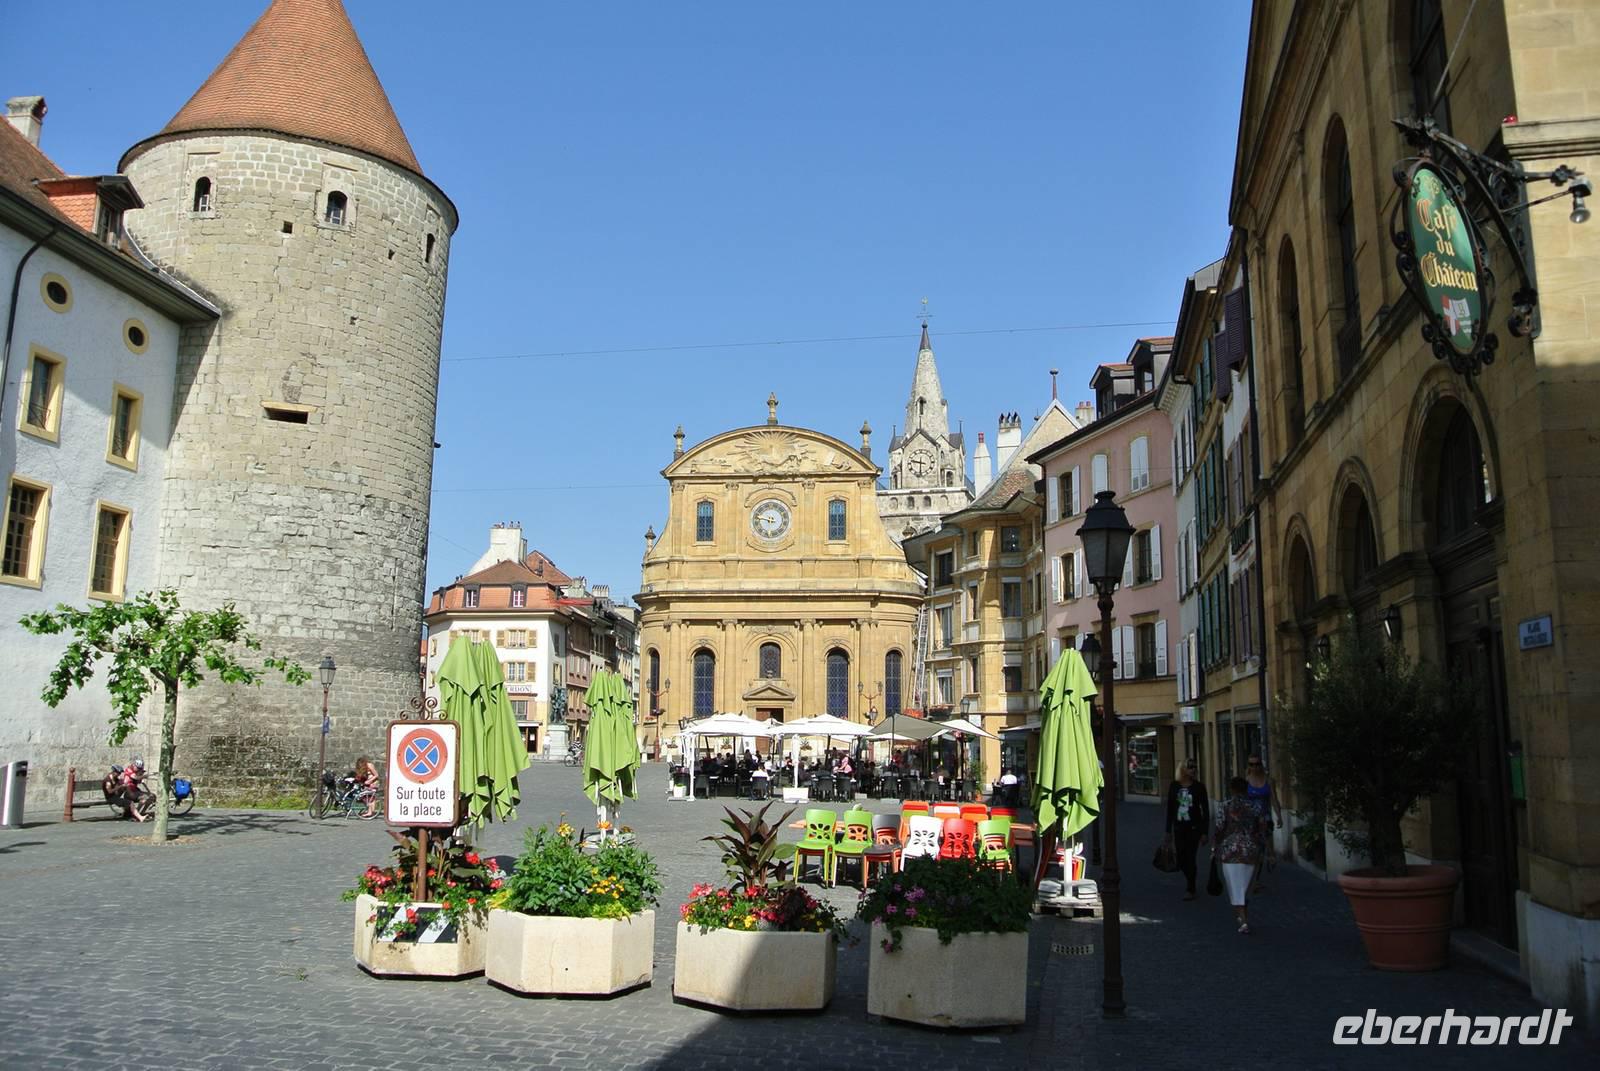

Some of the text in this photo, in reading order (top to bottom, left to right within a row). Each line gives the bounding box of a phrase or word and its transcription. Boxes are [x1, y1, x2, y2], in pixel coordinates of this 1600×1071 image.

[1416, 198, 1457, 240] Café
[1434, 229, 1455, 257] du
[1420, 252, 1479, 292] Château
[396, 786, 446, 800] Sur toute
[399, 803, 442, 818] la place
